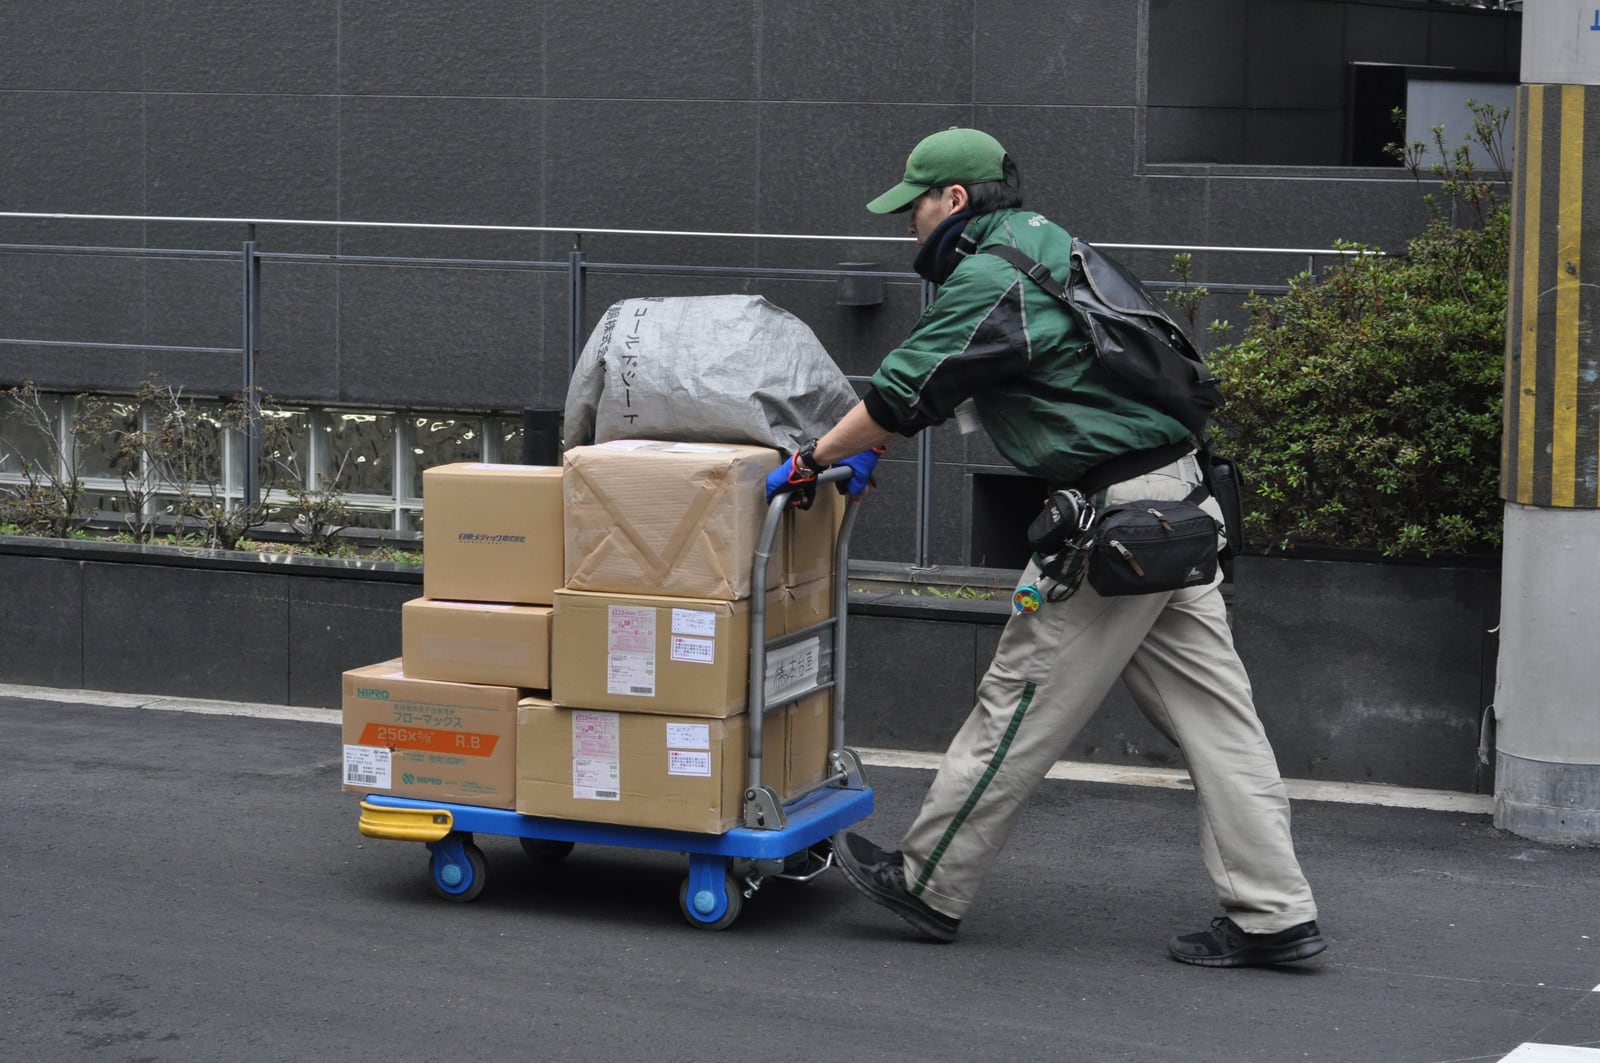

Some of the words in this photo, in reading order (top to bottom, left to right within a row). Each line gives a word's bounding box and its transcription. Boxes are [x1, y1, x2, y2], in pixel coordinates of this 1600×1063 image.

[621, 307, 648, 424] コールドシート
[356, 687, 390, 700] NIPRO
[392, 711, 464, 728] フローマックス
[416, 776, 442, 786] NIPRO
